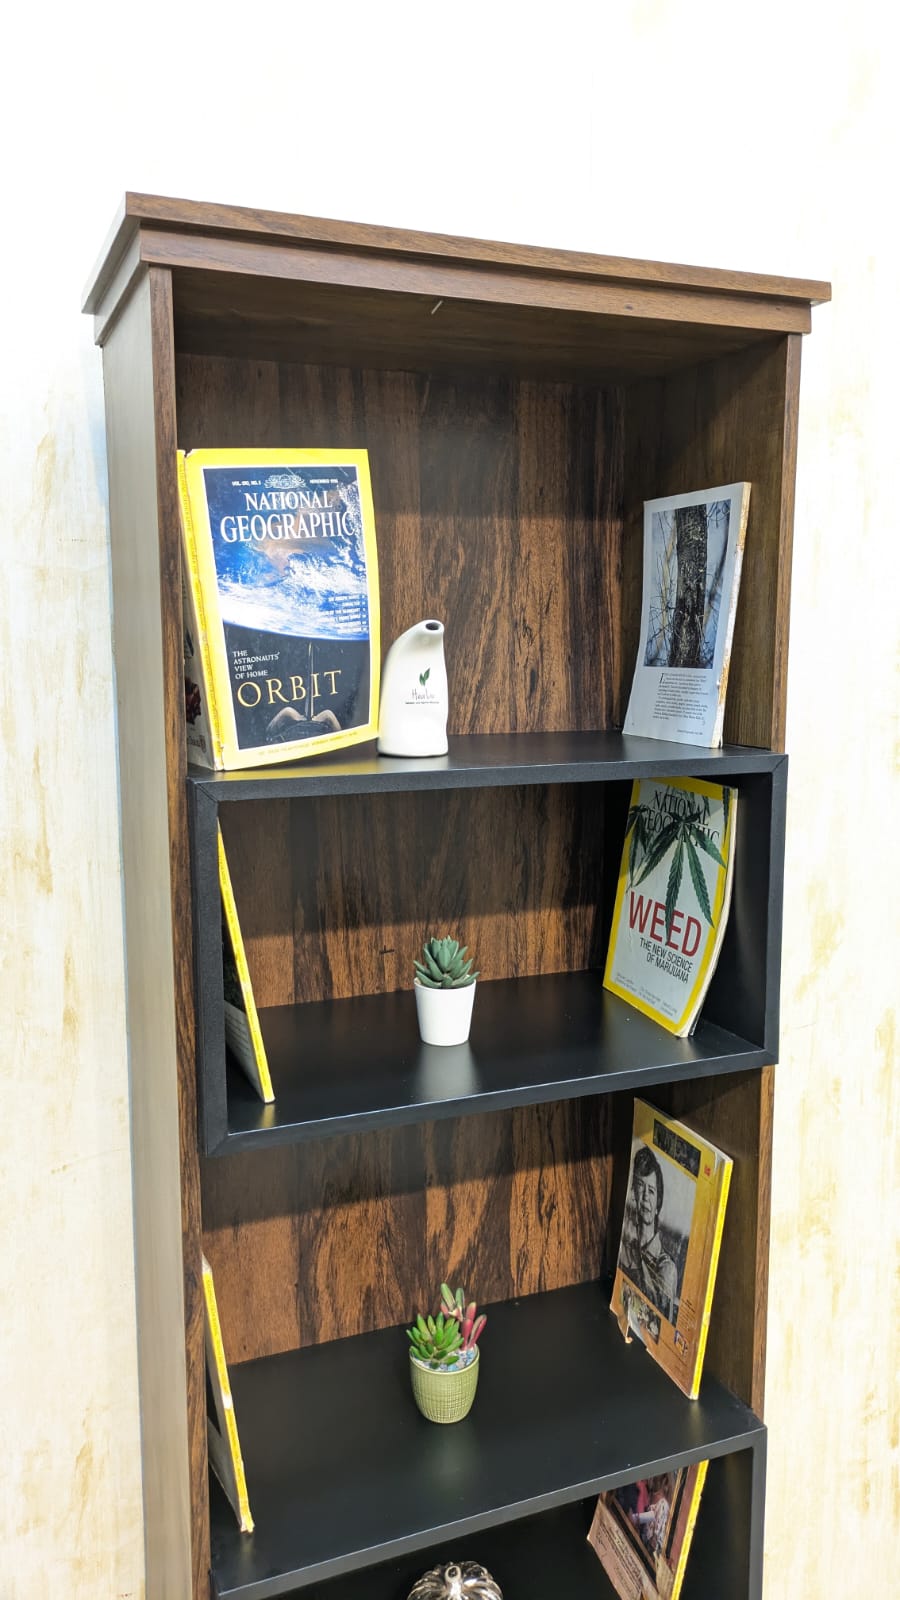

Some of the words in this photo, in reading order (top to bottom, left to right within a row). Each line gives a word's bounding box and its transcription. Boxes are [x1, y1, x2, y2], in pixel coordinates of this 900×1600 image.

[243, 490, 333, 511] NATIONAL
[220, 511, 356, 543] GEOGRAPHIC
[234, 664, 254, 672] VIEW
[246, 670, 269, 678] HOME
[237, 670, 342, 707] ORBIT
[629, 890, 702, 957] WEED
[640, 937, 652, 952] THE
[652, 943, 667, 959] NEW
[667, 951, 693, 973] SCIENCE
[646, 952, 655, 964] OF
[655, 957, 689, 984] MARIJUANA
